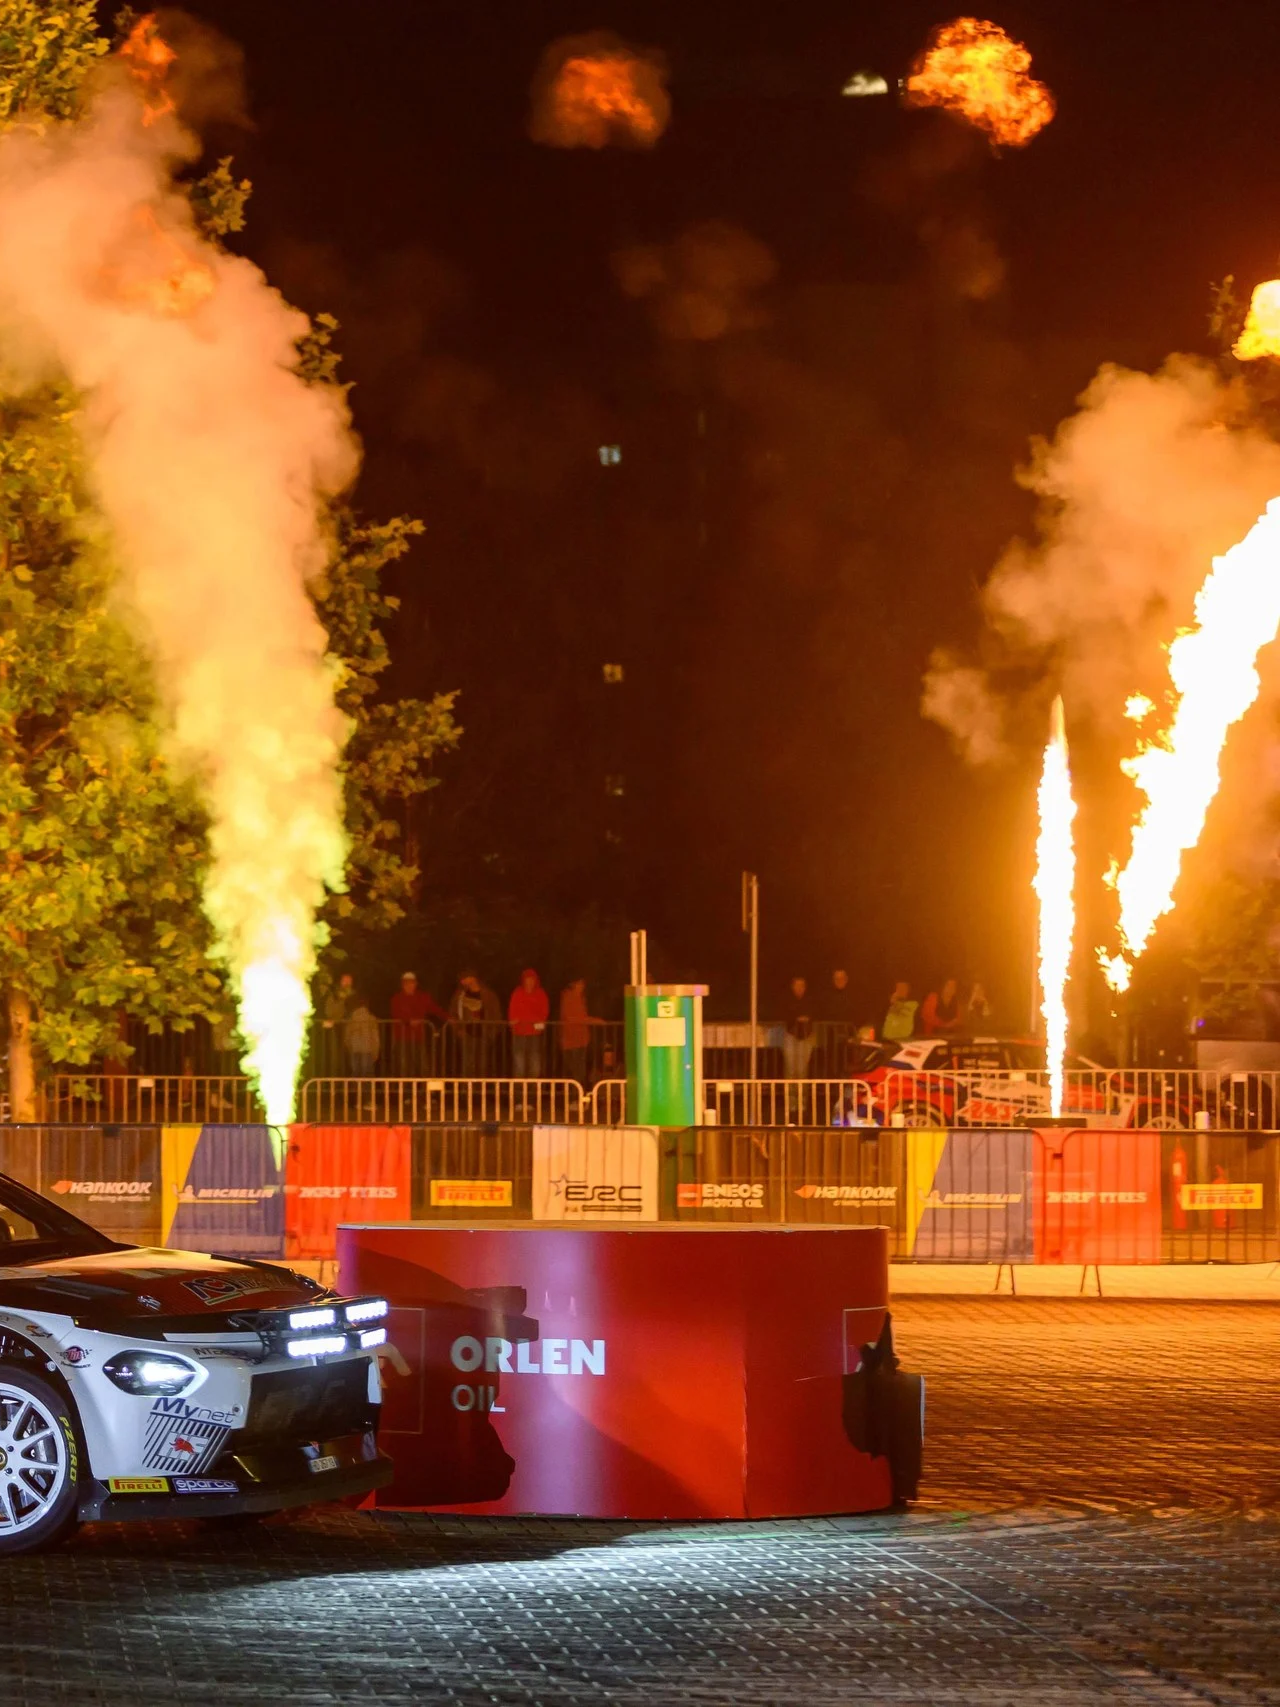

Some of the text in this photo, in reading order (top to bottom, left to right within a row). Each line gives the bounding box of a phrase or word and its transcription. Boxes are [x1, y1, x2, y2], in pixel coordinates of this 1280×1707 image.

[197, 1188, 275, 1198] MICHELIN
[349, 1187, 397, 1198] TYRES
[438, 1185, 505, 1201] PIRELLI
[565, 1185, 643, 1201] ERC
[702, 1183, 764, 1198] ENEOS
[451, 1336, 605, 1375] ORLEN
[452, 1384, 506, 1413] OIL
[152, 1397, 235, 1424] Mynet
[115, 1480, 163, 1490] PIRELLI
[176, 1481, 233, 1491] sparco
